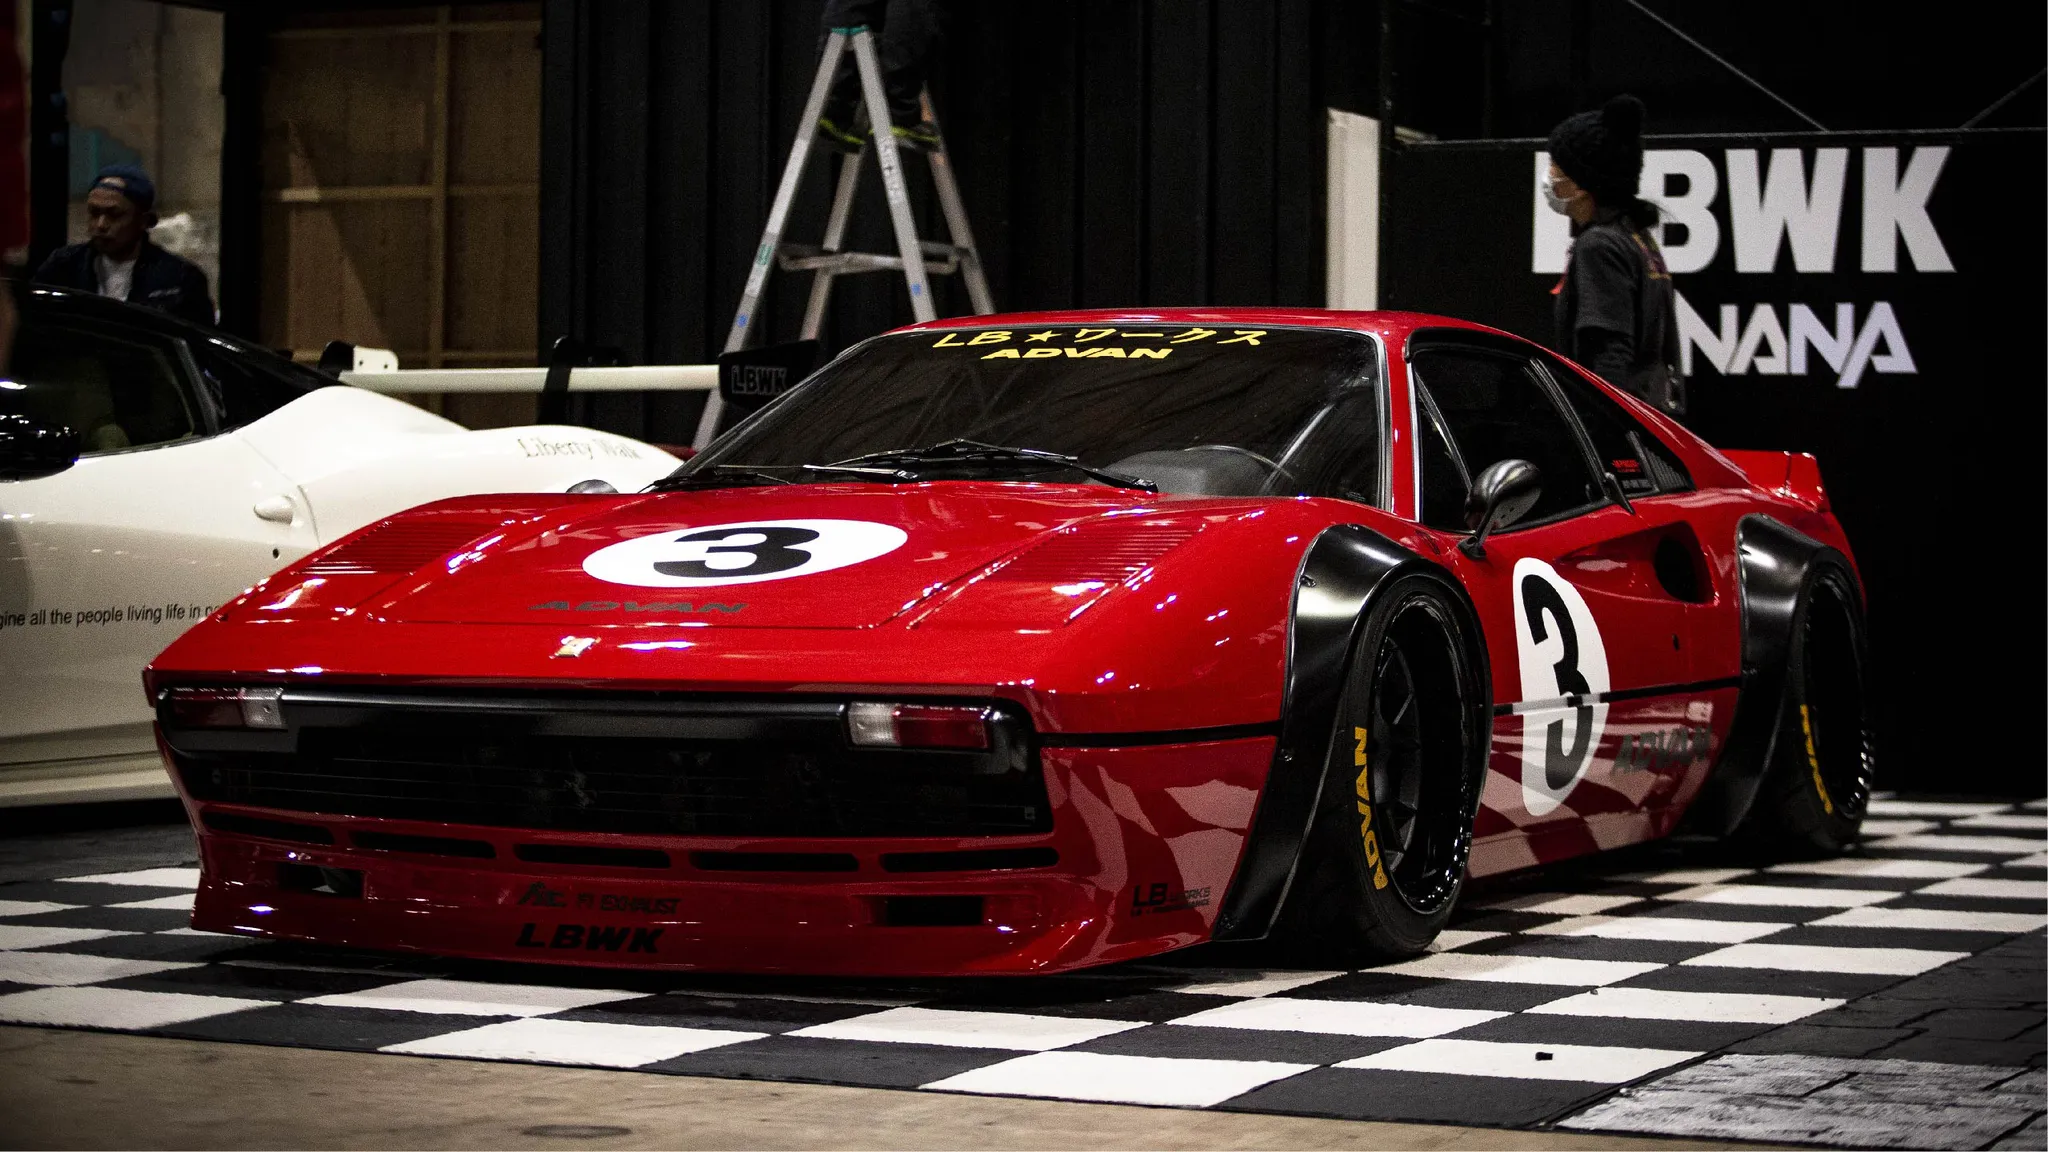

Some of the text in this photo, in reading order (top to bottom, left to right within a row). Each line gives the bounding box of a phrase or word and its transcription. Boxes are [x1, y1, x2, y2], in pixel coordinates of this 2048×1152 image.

[980, 348, 1173, 360] ADVAN
[517, 437, 594, 461] Liberty
[653, 526, 820, 578] 3
[30, 609, 46, 626] all
[50, 609, 72, 624] the
[76, 606, 123, 628] people
[127, 605, 162, 624] living
[165, 604, 186, 620] life
[189, 603, 201, 619] in
[527, 601, 748, 613] ADVAN
[1521, 574, 1593, 791] 3
[1355, 726, 1388, 890] ADVAN
[1133, 882, 1168, 907] LB
[514, 922, 665, 954] LBWK
